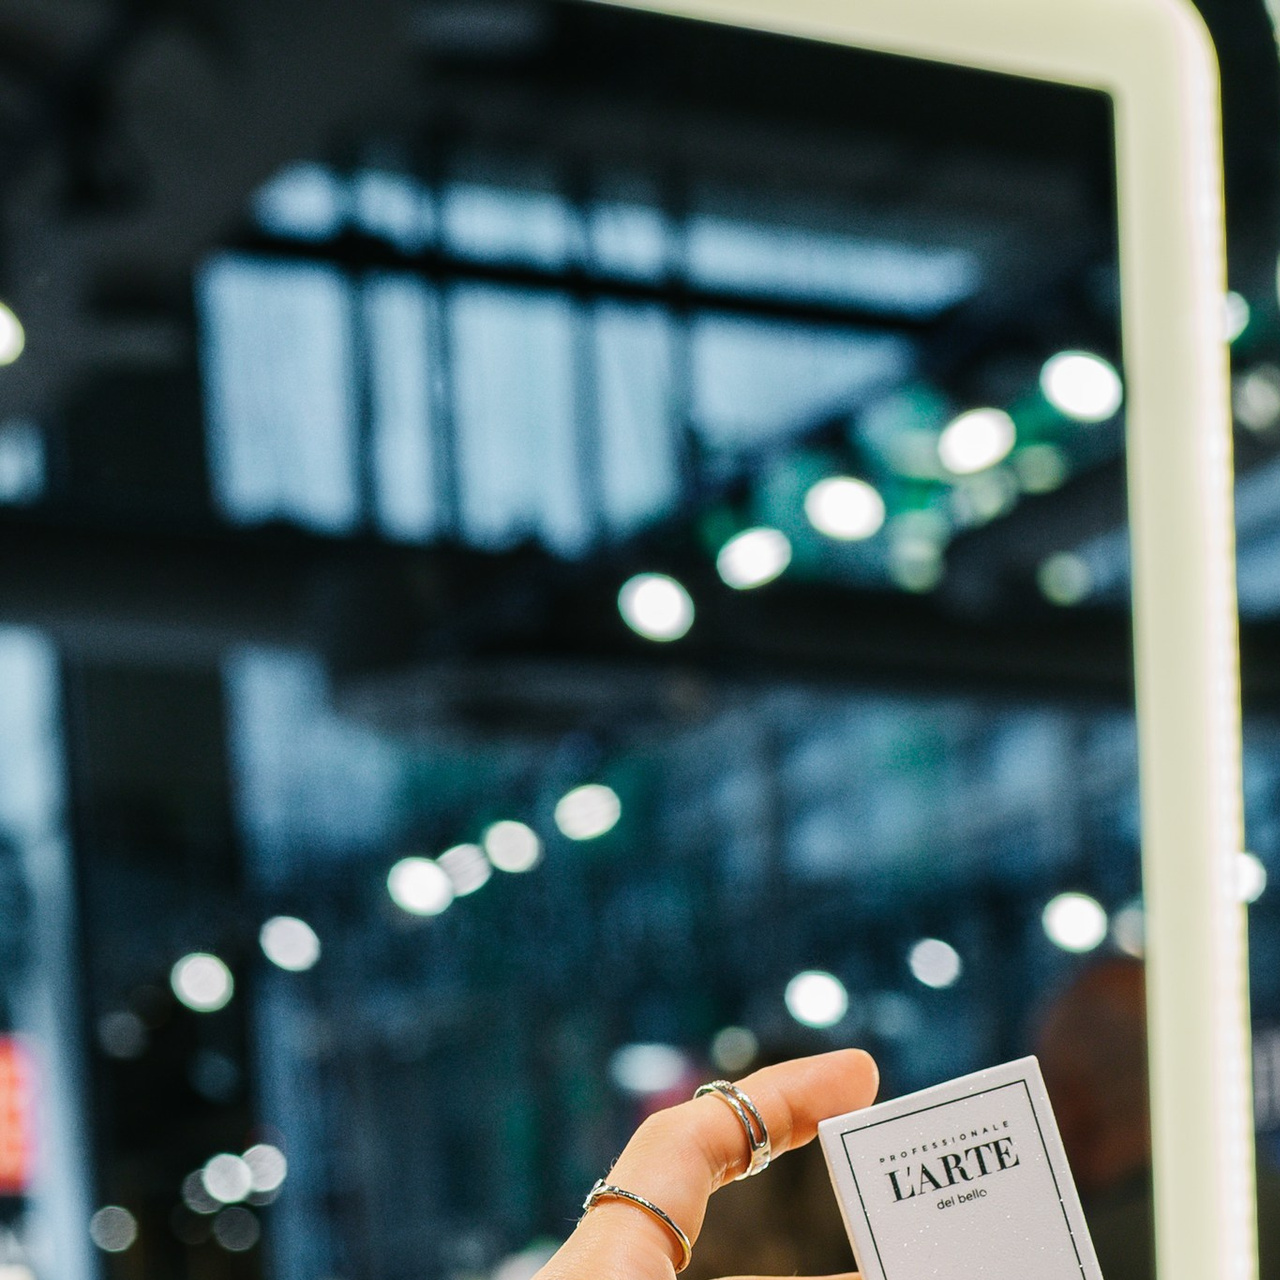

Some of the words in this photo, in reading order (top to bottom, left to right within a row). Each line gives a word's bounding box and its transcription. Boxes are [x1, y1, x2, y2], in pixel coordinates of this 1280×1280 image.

[879, 1120, 1009, 1163] PROFESSIONALE
[885, 1136, 1020, 1203] L'ARTE
[936, 1196, 955, 1210] del
[959, 1188, 988, 1204] bello
